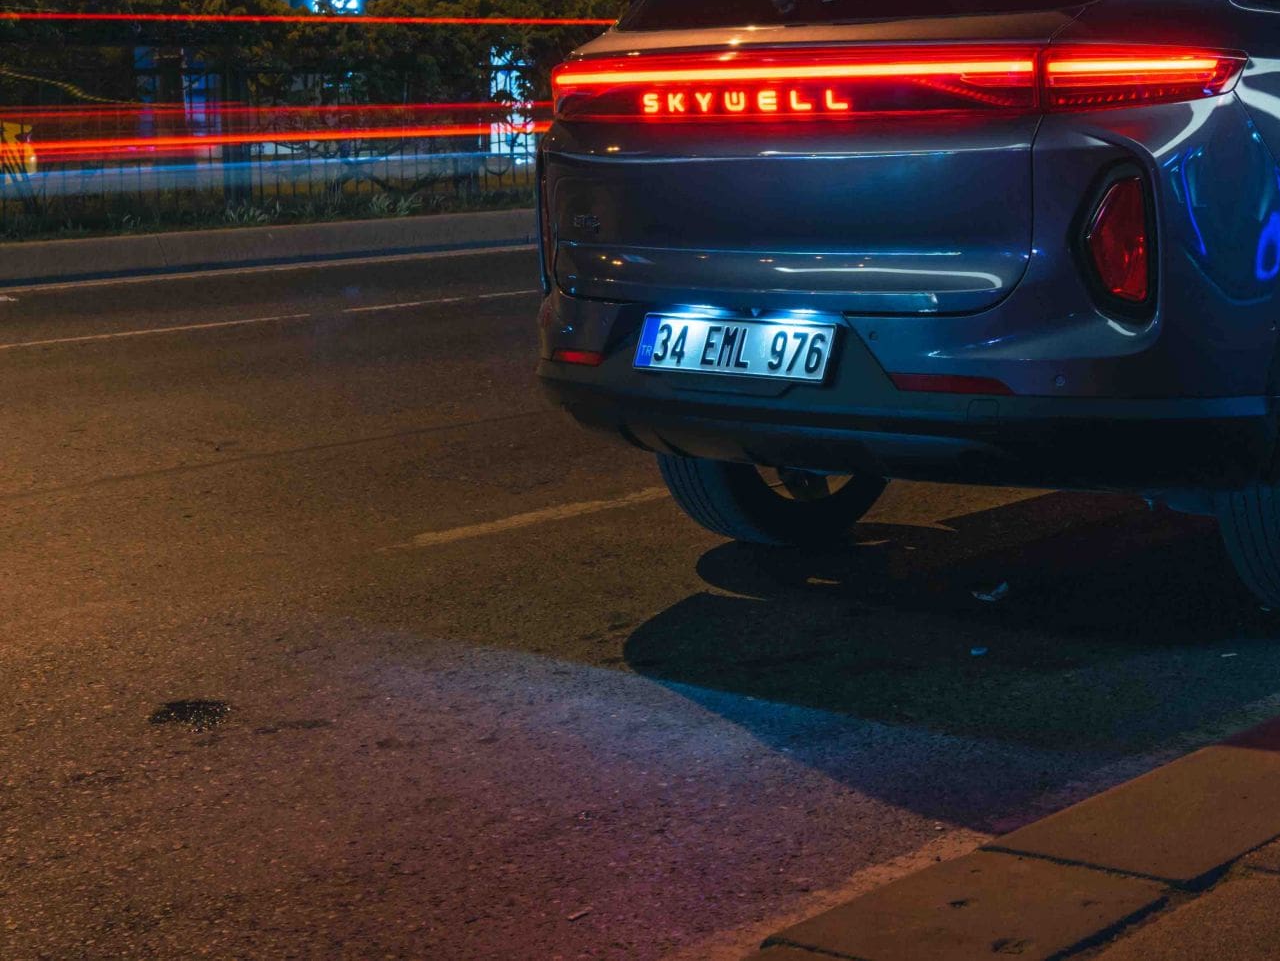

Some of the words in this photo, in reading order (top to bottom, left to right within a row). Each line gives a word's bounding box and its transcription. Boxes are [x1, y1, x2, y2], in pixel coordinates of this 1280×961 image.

[642, 89, 849, 113] SKYWELL
[653, 323, 689, 365] 34
[700, 325, 749, 369] EML
[767, 330, 826, 374] 976
